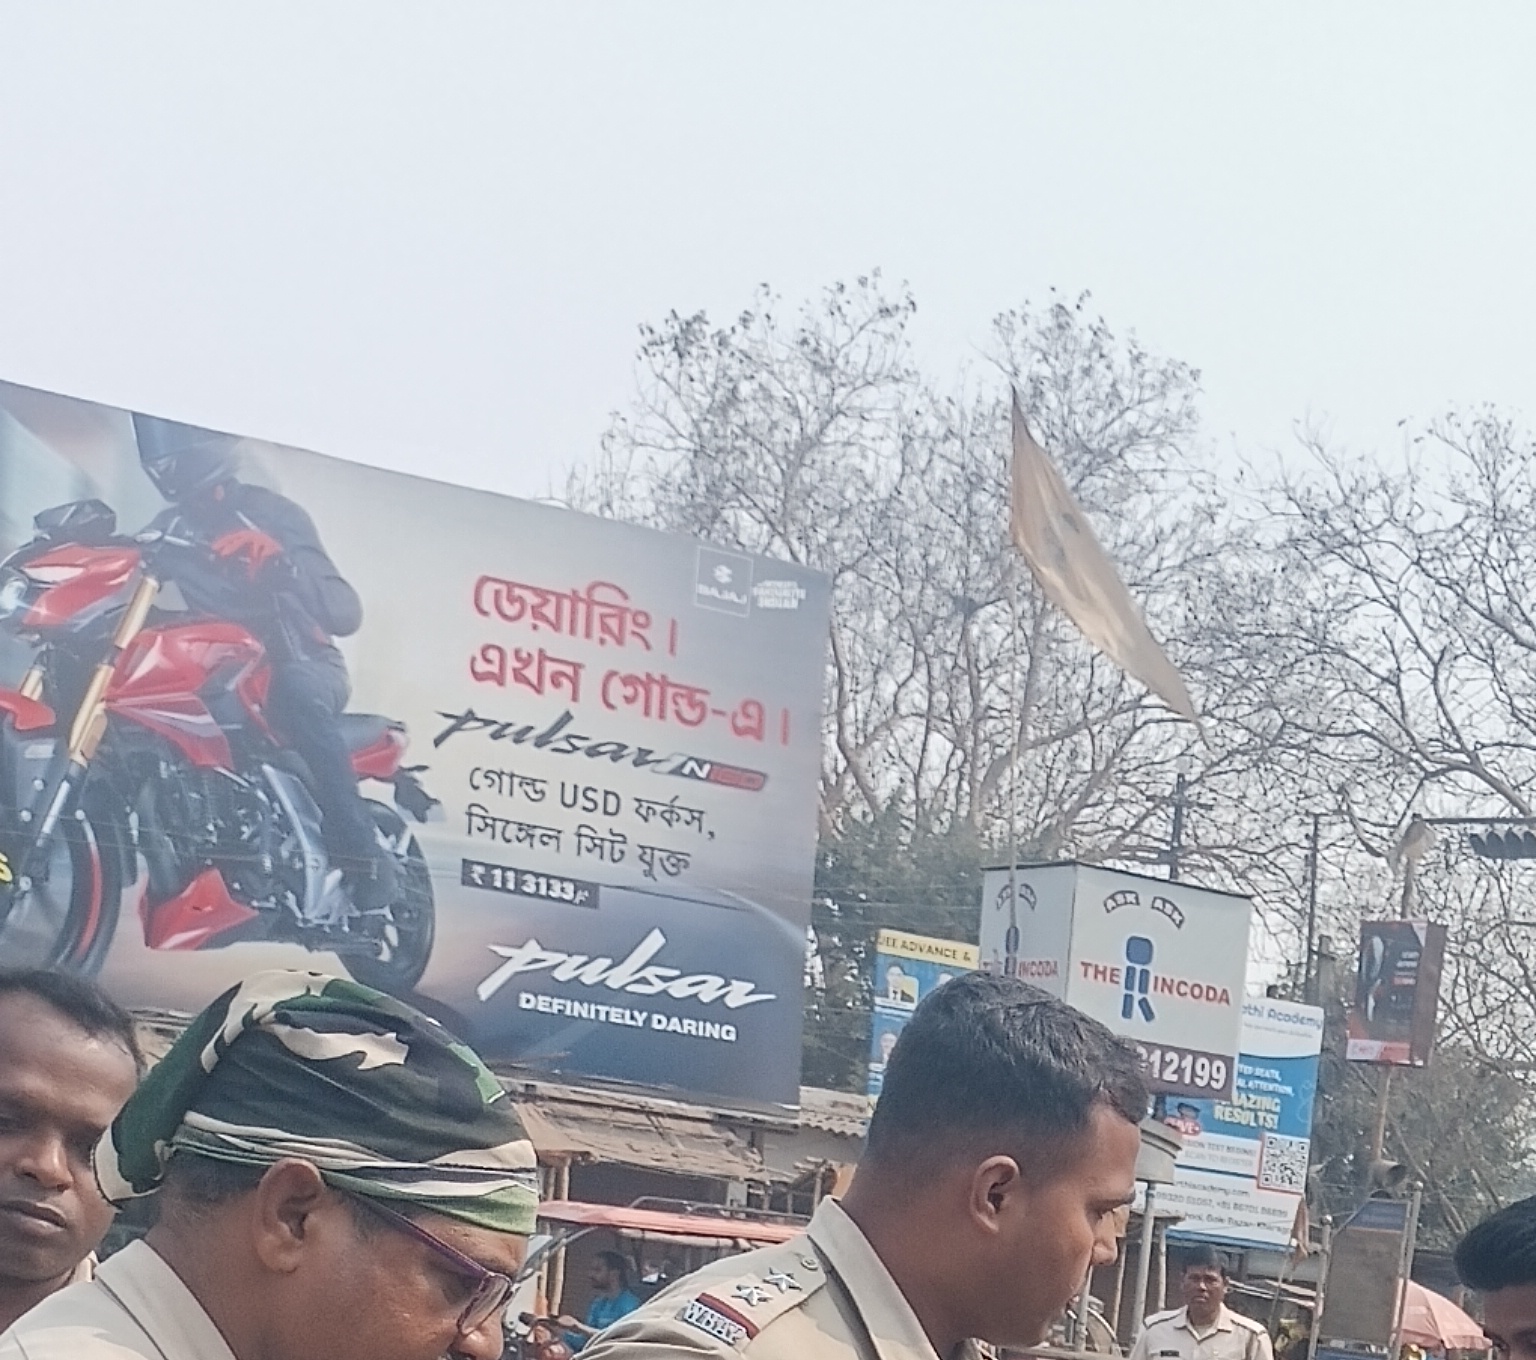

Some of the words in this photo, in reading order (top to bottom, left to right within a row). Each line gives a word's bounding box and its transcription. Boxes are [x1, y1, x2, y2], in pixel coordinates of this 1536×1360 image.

[470, 643, 585, 702] এখন
[433, 708, 671, 768] pulsar
[560, 781, 621, 817] USD
[577, 824, 628, 864] সিট
[638, 844, 691, 881] যুক্ত
[476, 927, 777, 1009] pulsar
[900, 939, 959, 961] ADVANCE
[1080, 960, 1121, 984] THE
[1153, 975, 1231, 1007] INCODA
[519, 992, 648, 1027] DEFINITELY
[651, 1013, 737, 1042] DARING
[1267, 1007, 1323, 1031] Academy
[1214, 1091, 1281, 1114] AZING
